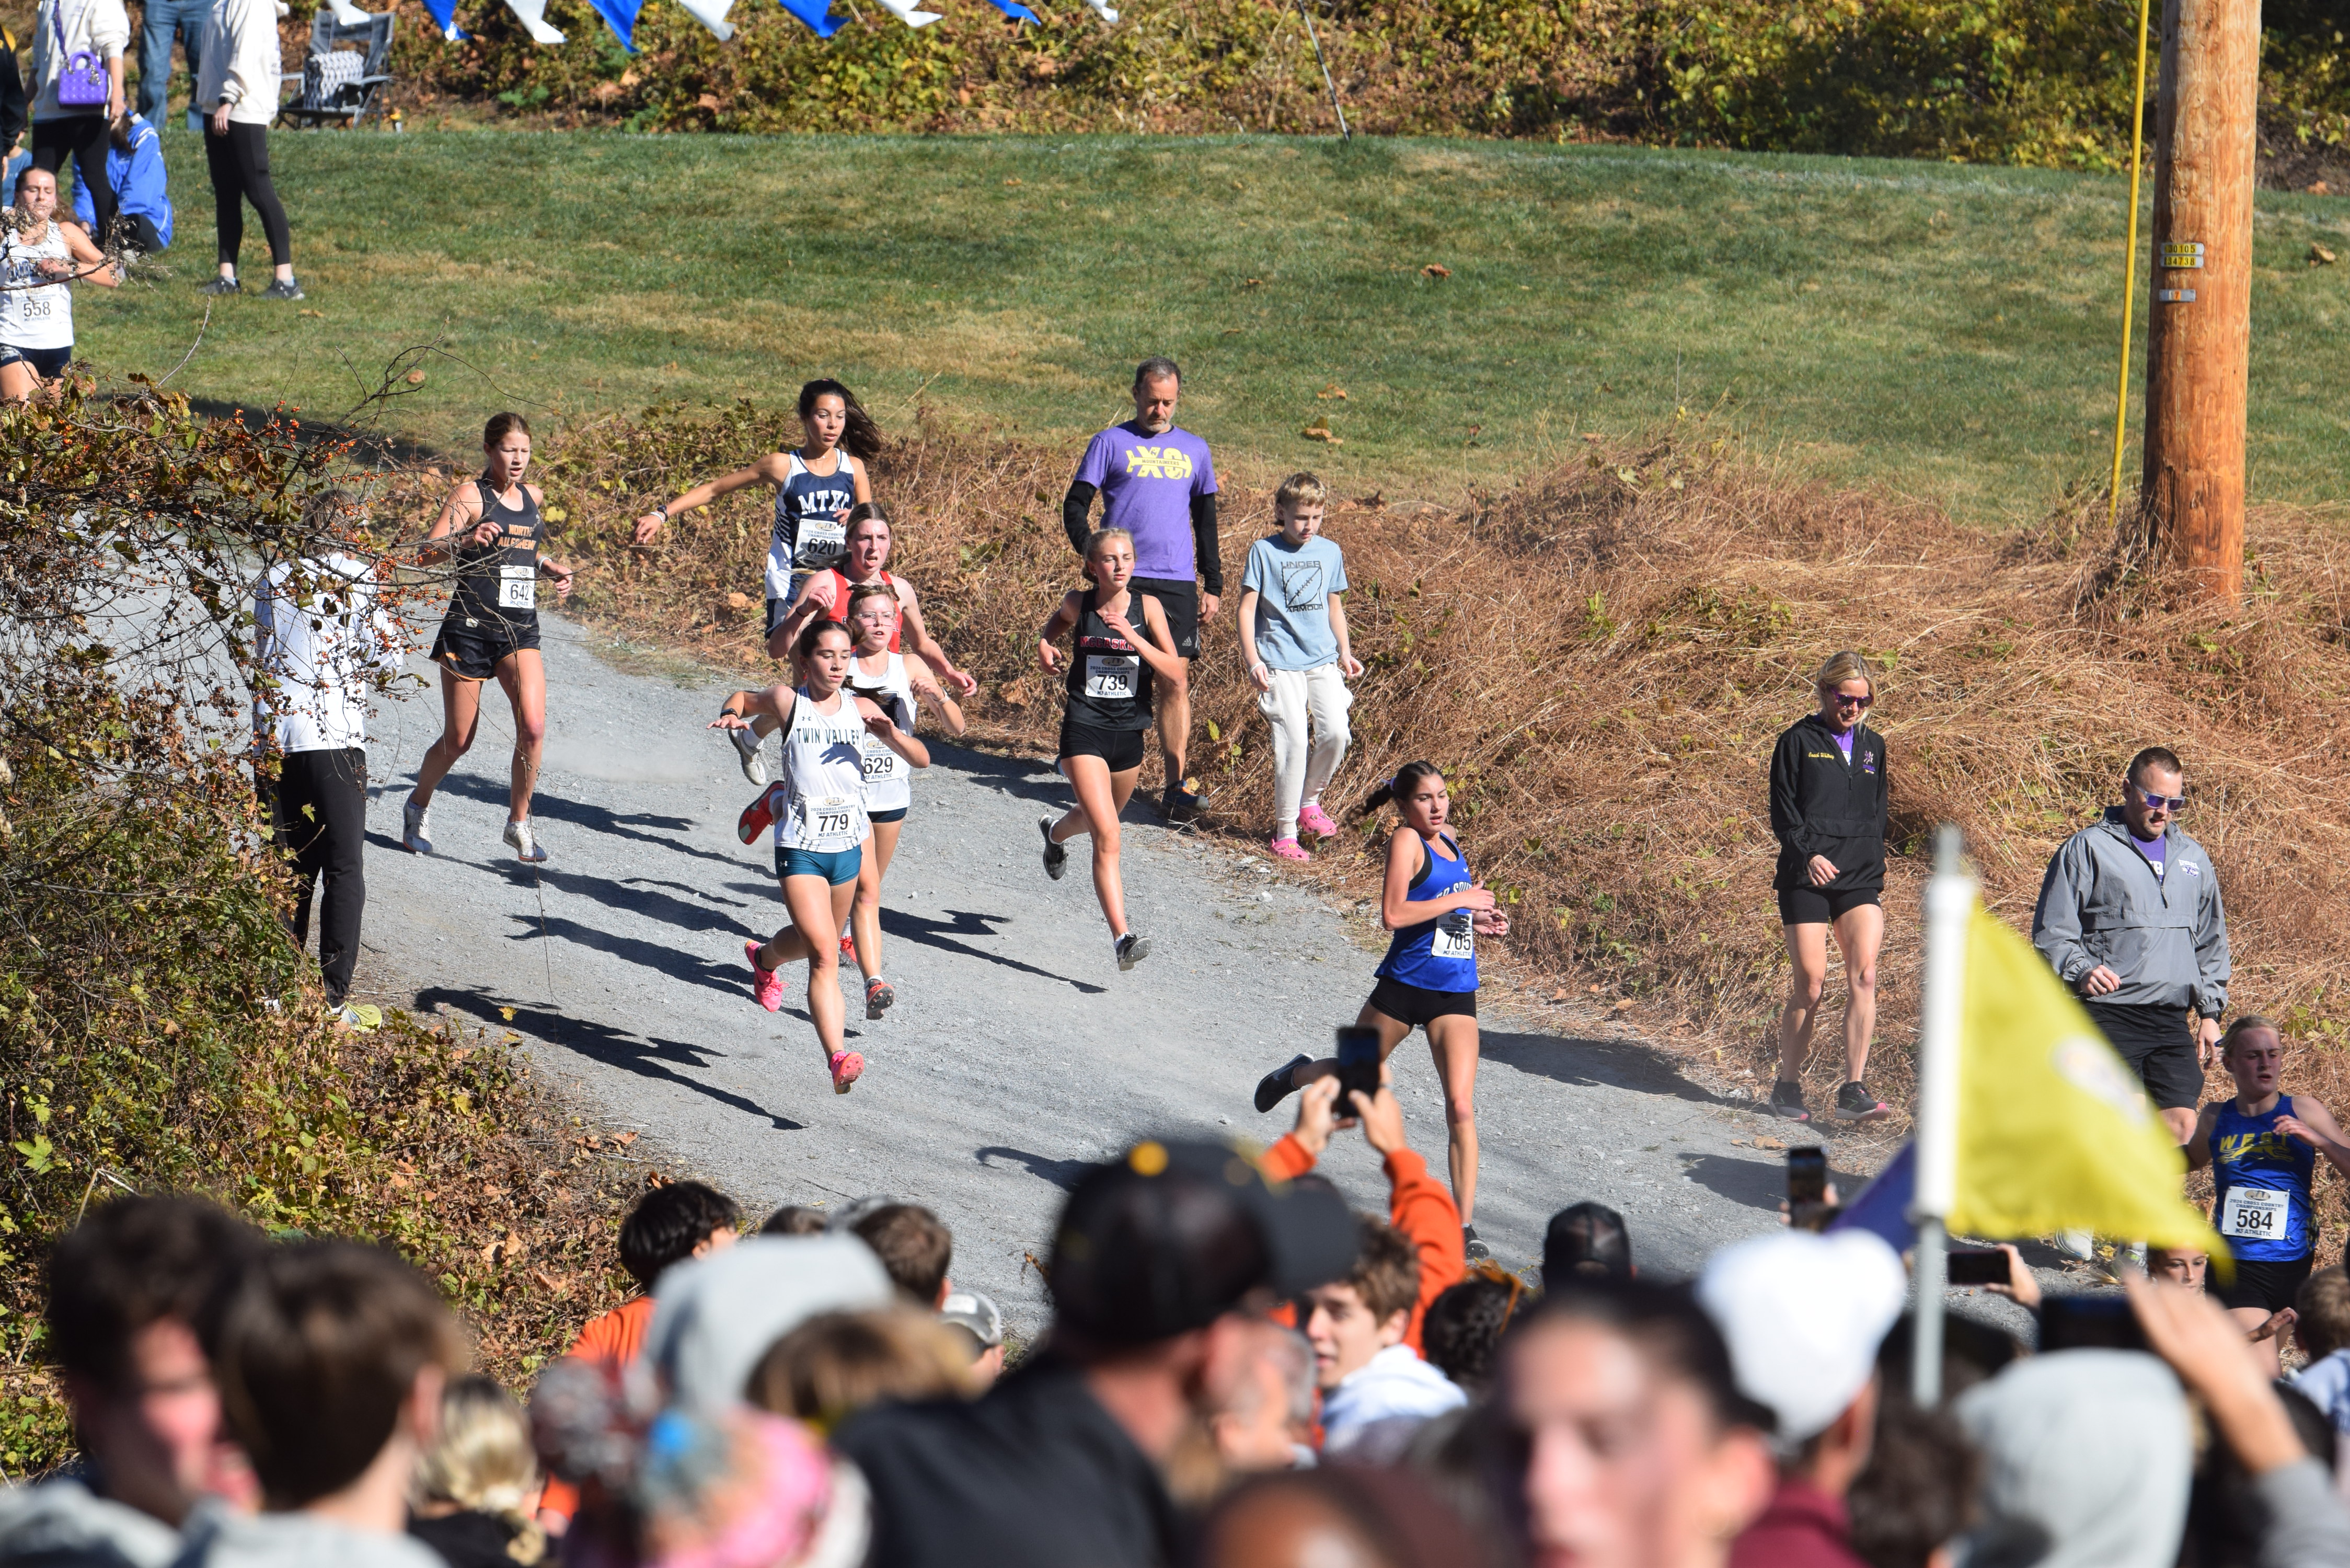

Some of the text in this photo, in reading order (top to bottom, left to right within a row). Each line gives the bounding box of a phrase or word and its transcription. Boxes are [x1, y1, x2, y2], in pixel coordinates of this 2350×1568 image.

[24, 302, 51, 317] 558
[1136, 446, 1183, 479] XC
[497, 536, 537, 550] ALLEGHEN
[808, 538, 837, 555] 620
[1281, 560, 1321, 569] UNDER
[511, 584, 529, 601] 642
[1286, 604, 1323, 613] ARMOUR
[1080, 636, 1135, 651] MCCASKE
[1097, 674, 1127, 690] 739
[796, 728, 820, 743] TWIN
[825, 729, 859, 745] VALLEY
[864, 757, 893, 774] 629
[819, 814, 848, 832] 779
[1446, 932, 1471, 950] 705
[2236, 1208, 2273, 1230] 584
